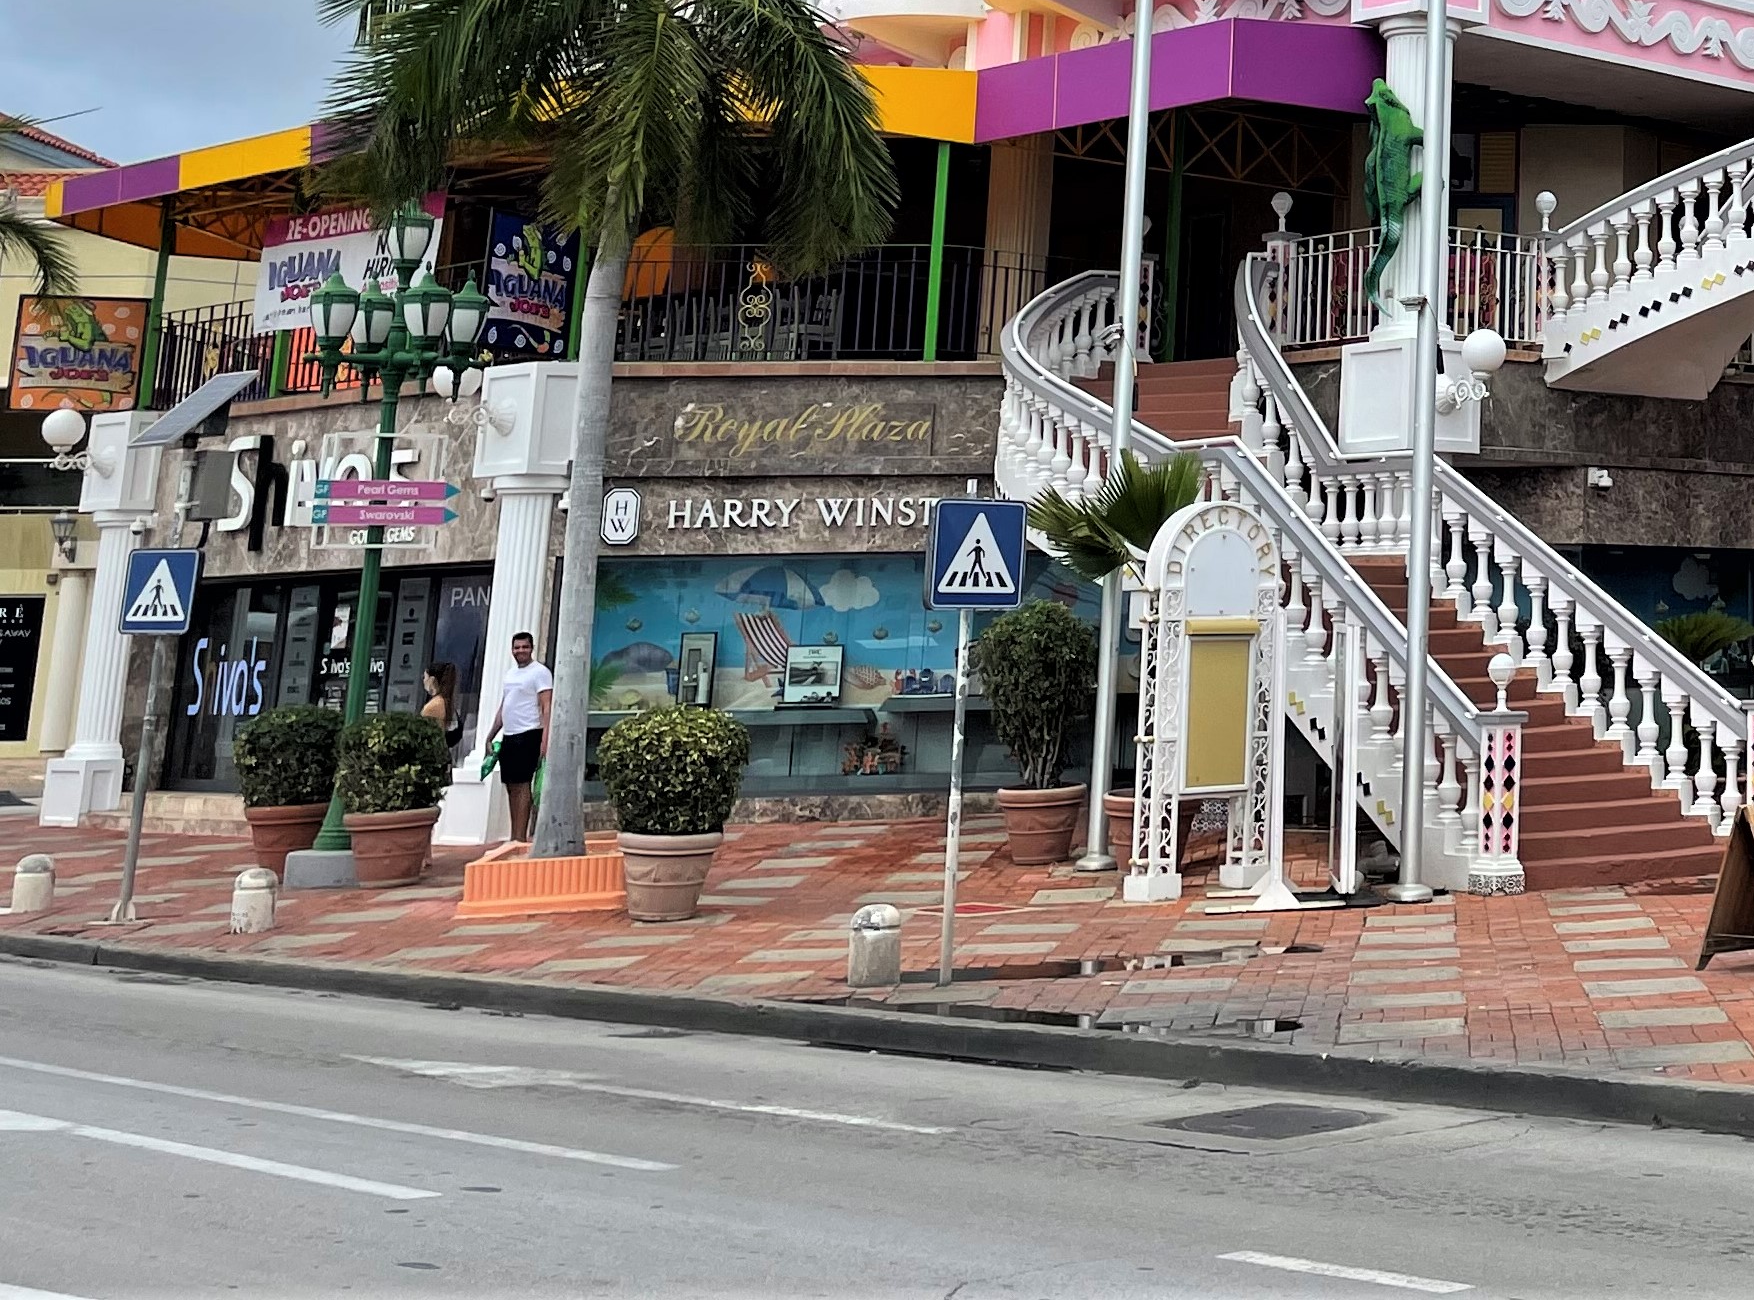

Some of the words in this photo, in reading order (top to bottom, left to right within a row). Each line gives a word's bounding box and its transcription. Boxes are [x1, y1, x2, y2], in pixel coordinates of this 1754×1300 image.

[286, 207, 373, 241] RE-OPENING
[269, 248, 341, 291] IGUANA
[363, 257, 396, 280] HIRI
[492, 269, 567, 309] IGUANA
[25, 345, 132, 373] IGUANA
[675, 403, 820, 457] Royal
[814, 402, 931, 442] Plaza
[357, 485, 385, 495] Pearl
[387, 485, 419, 495] Gems
[359, 509, 415, 520] Swarovski
[615, 500, 629, 516] H
[667, 498, 800, 529] HARRY
[387, 527, 415, 542] GEMS
[610, 518, 628, 534] W
[1167, 505, 1276, 577] DIRECTORY
